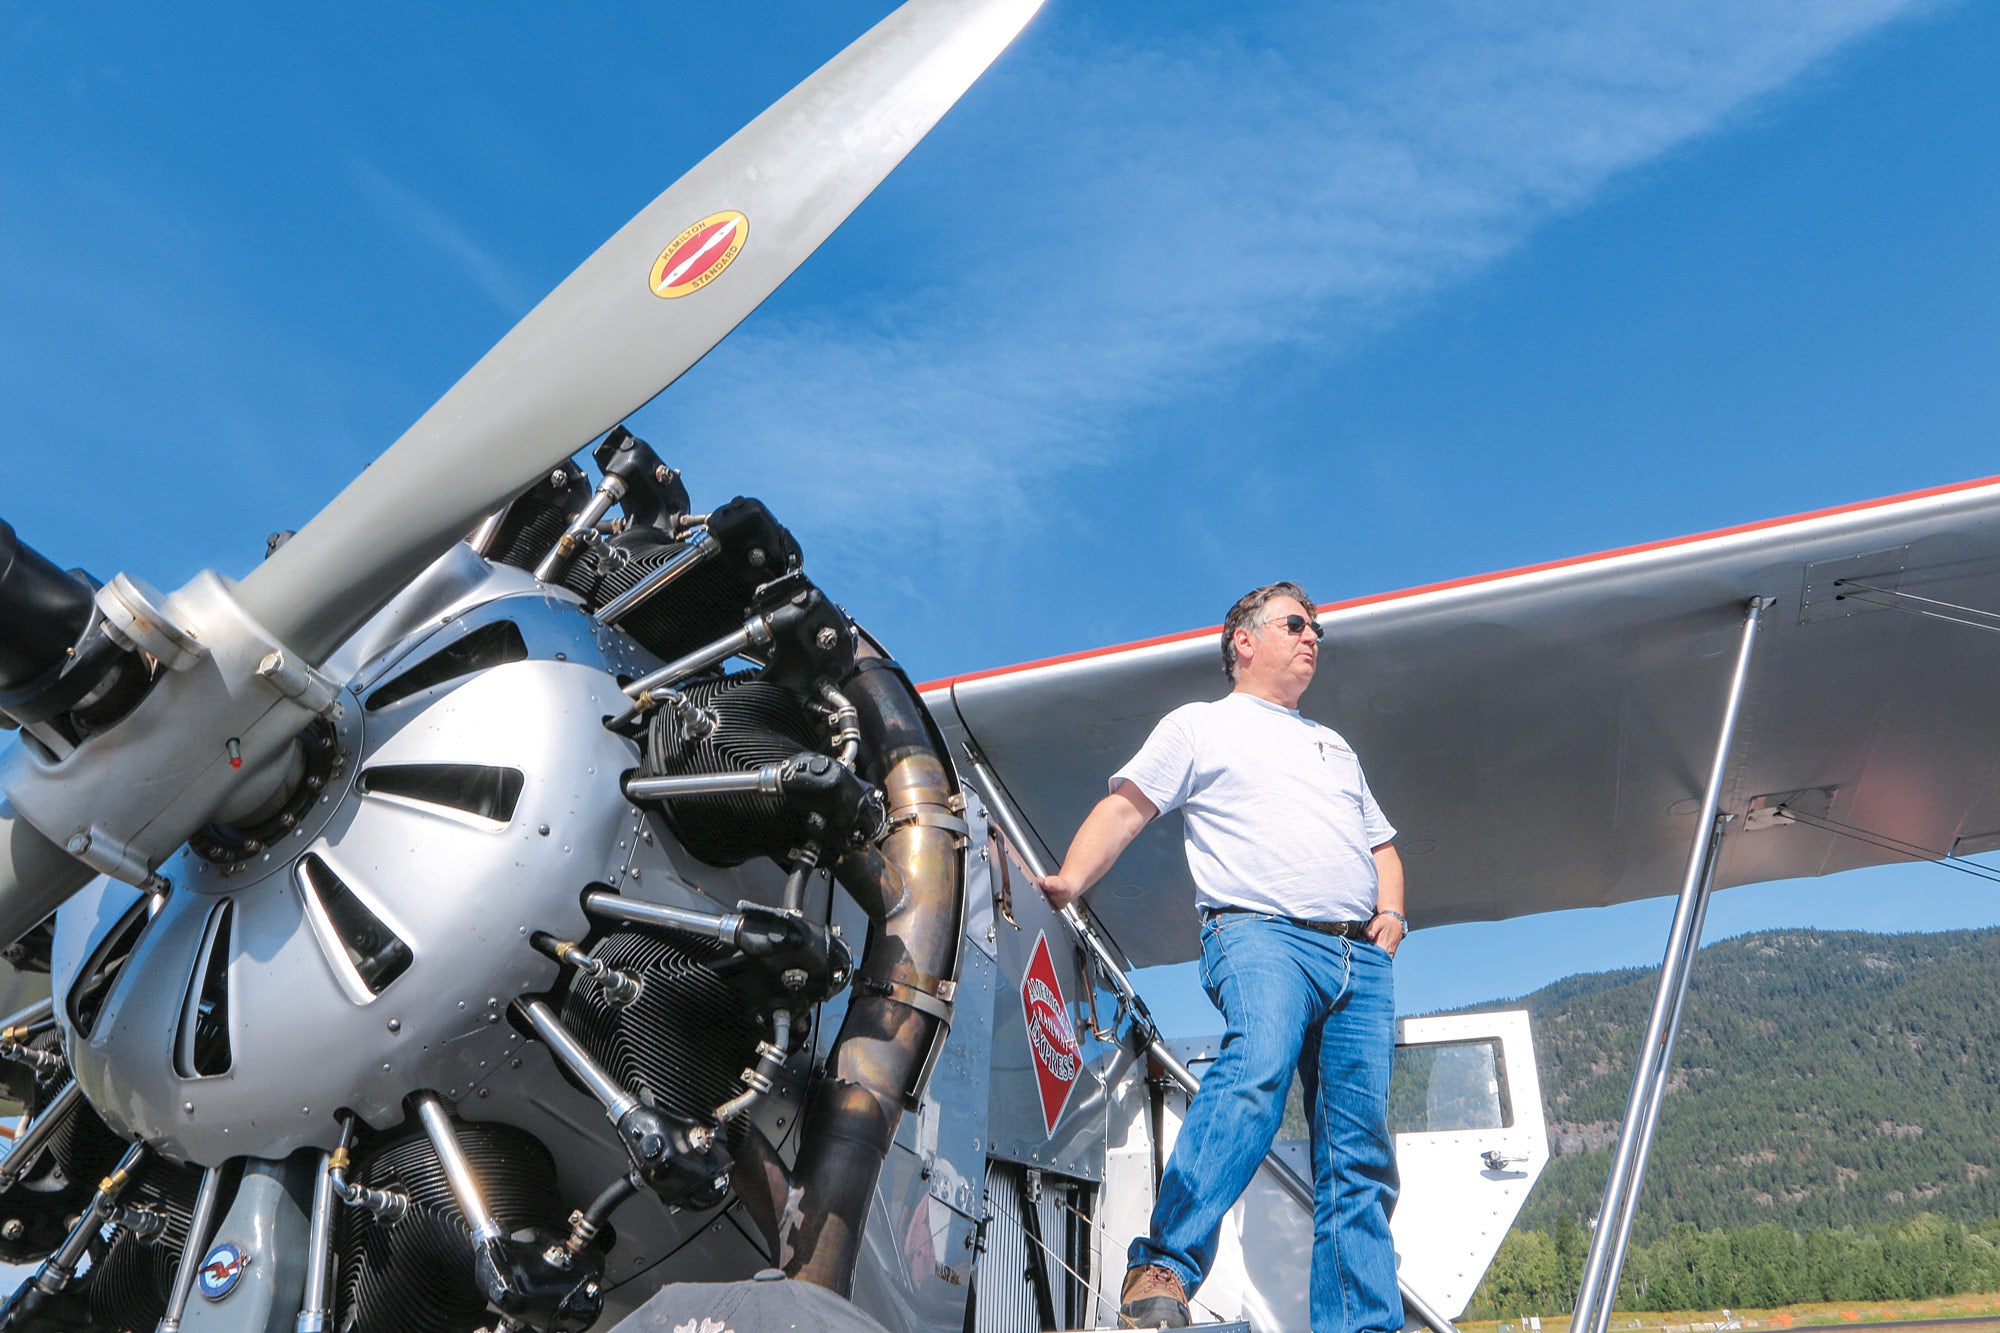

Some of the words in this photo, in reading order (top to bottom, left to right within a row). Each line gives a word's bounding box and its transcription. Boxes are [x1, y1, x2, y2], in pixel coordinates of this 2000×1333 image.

[662, 222, 706, 260] HAMILTON
[692, 246, 738, 288] STANDARD
[1028, 978, 1075, 1042] AMERICAN
[1038, 1005, 1071, 1052] RAILWAY
[1029, 1010, 1075, 1081] EXPRESS
